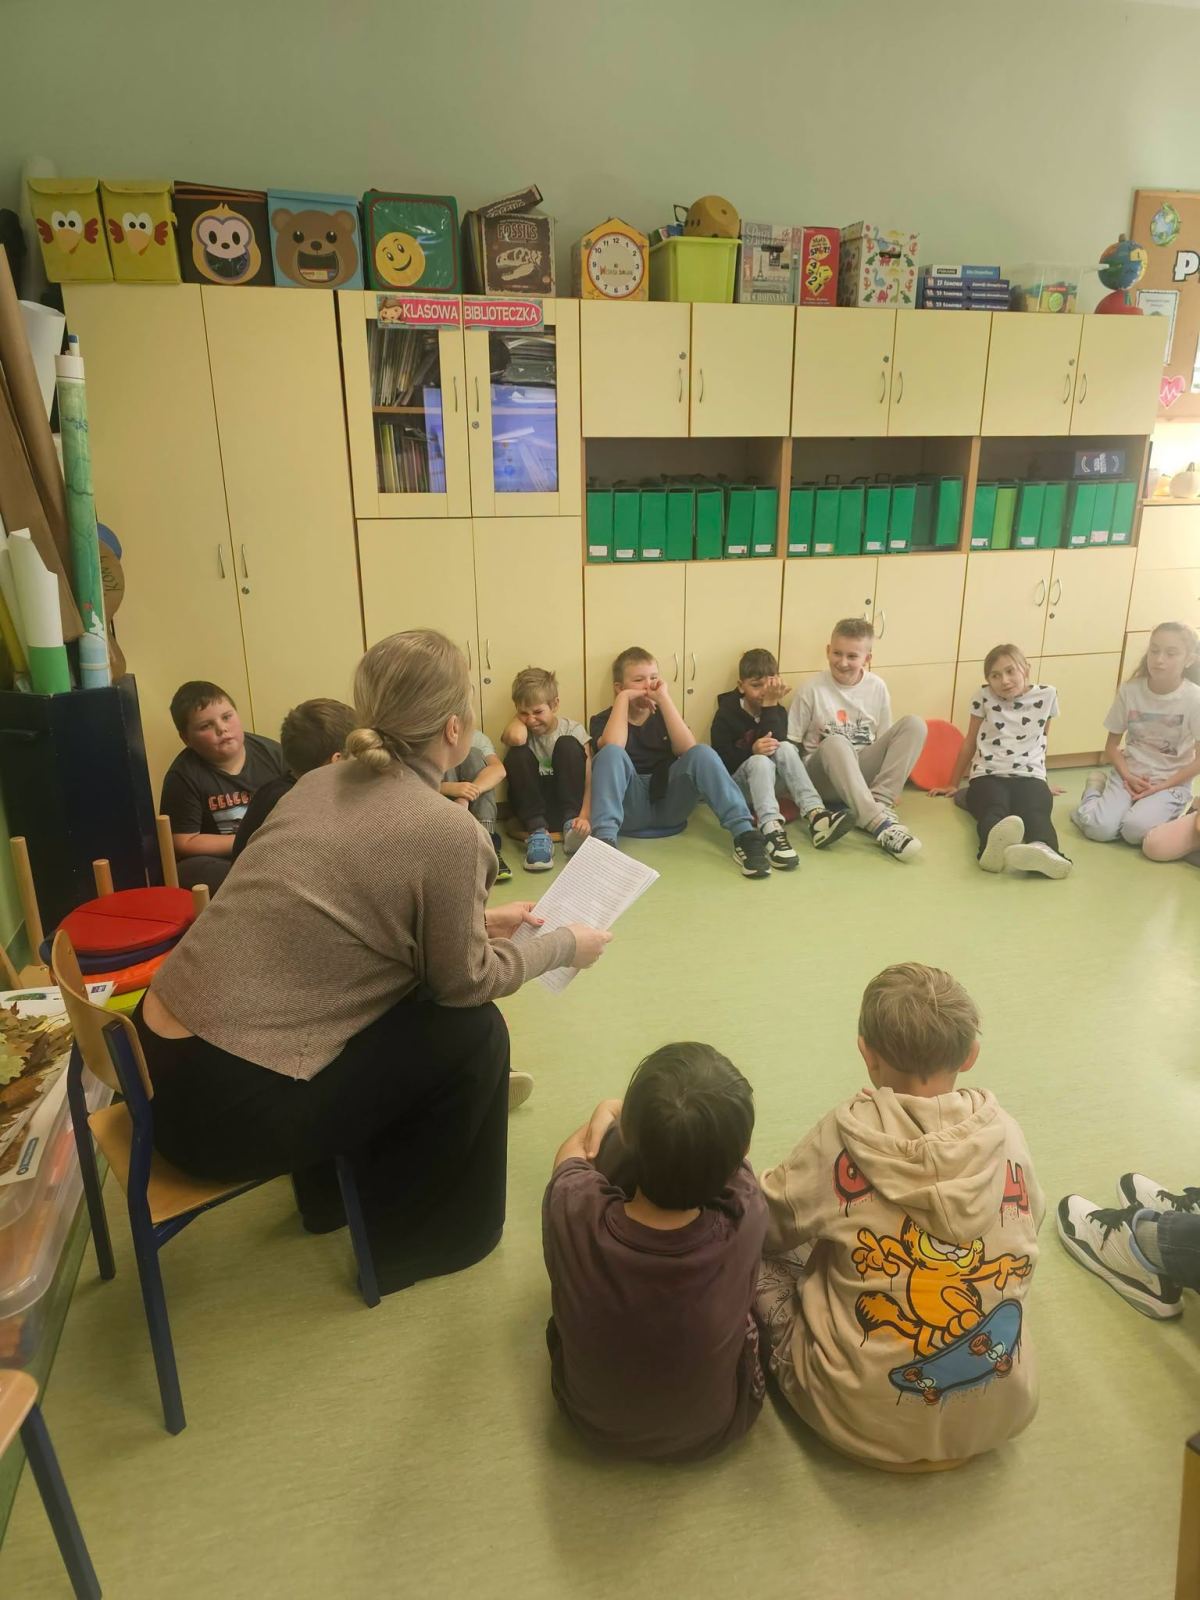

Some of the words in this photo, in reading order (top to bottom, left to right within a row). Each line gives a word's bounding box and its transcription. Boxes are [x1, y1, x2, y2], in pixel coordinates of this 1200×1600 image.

[497, 223, 539, 240] FOSSILS
[1172, 251, 1200, 283] P
[402, 303, 459, 320] KLASOWA
[464, 305, 538, 321] BIBLIOTECZKA
